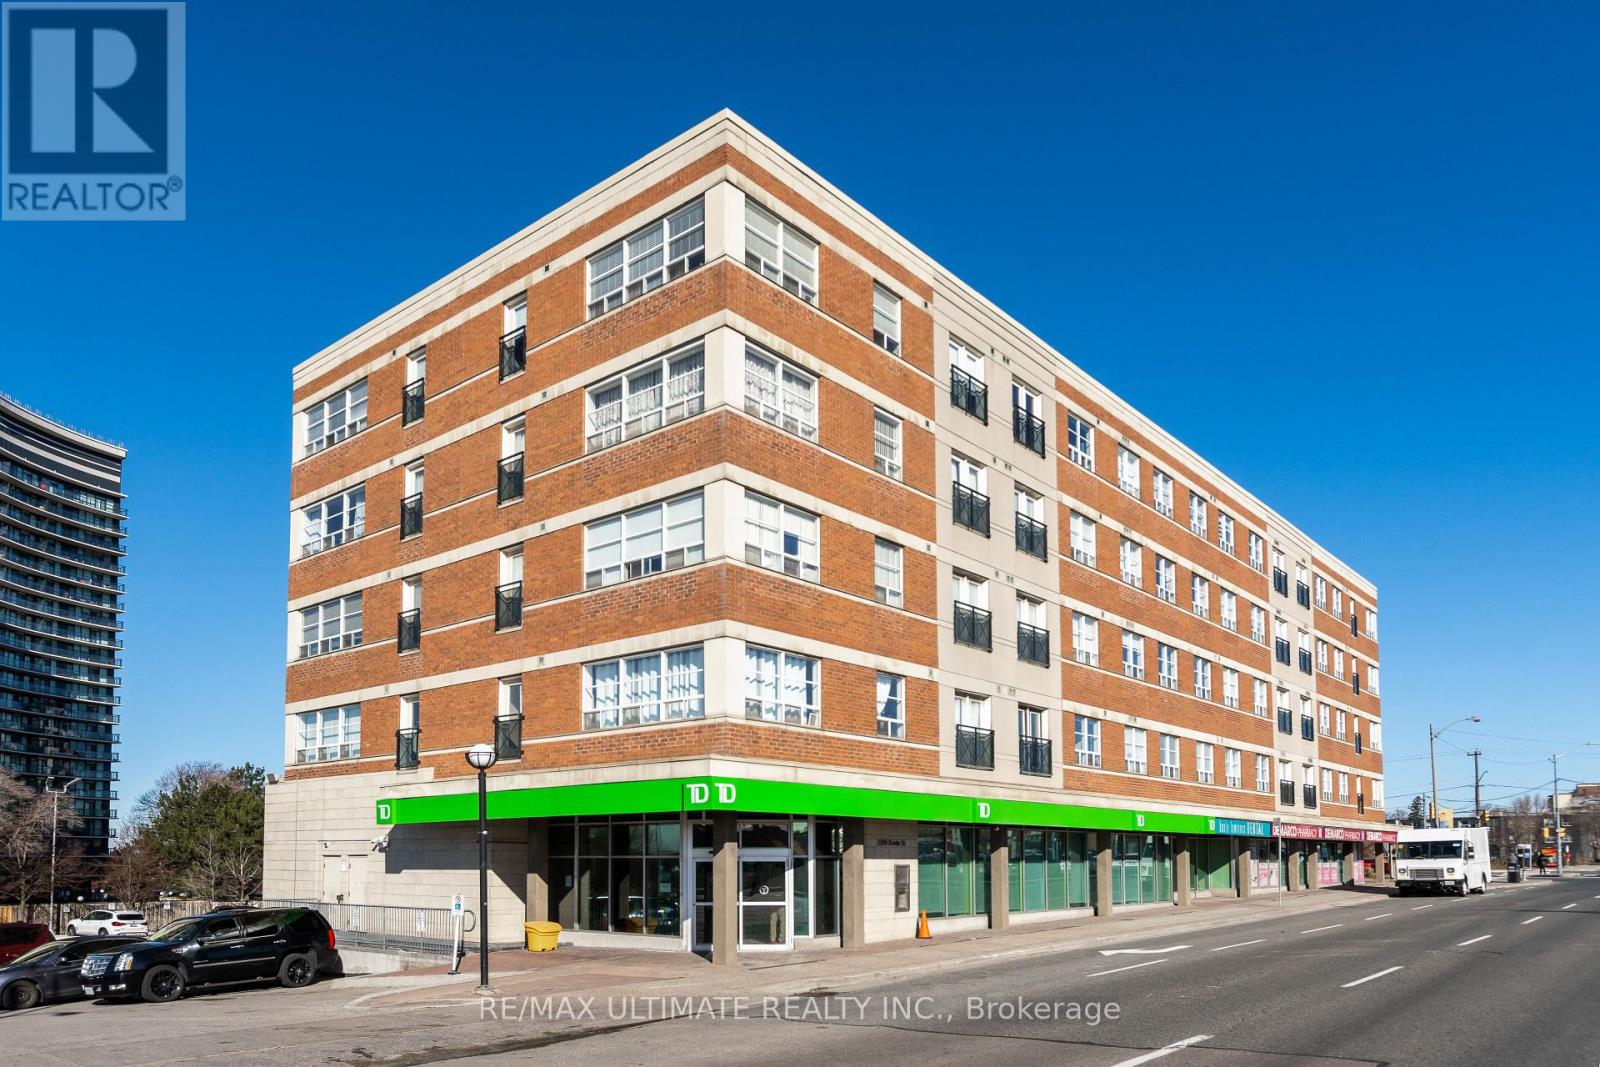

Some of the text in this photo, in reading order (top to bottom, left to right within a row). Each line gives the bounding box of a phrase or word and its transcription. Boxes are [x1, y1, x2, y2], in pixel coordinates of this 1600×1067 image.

[686, 783, 709, 804] TD
[714, 783, 736, 804] TD
[377, 804, 391, 820] TD
[977, 802, 991, 818] TD
[1136, 814, 1145, 827] TD
[1247, 821, 1264, 835] DENTAL
[1272, 825, 1317, 838] DEMARCO PHARMACY
[1324, 828, 1344, 840] DEMARCO
